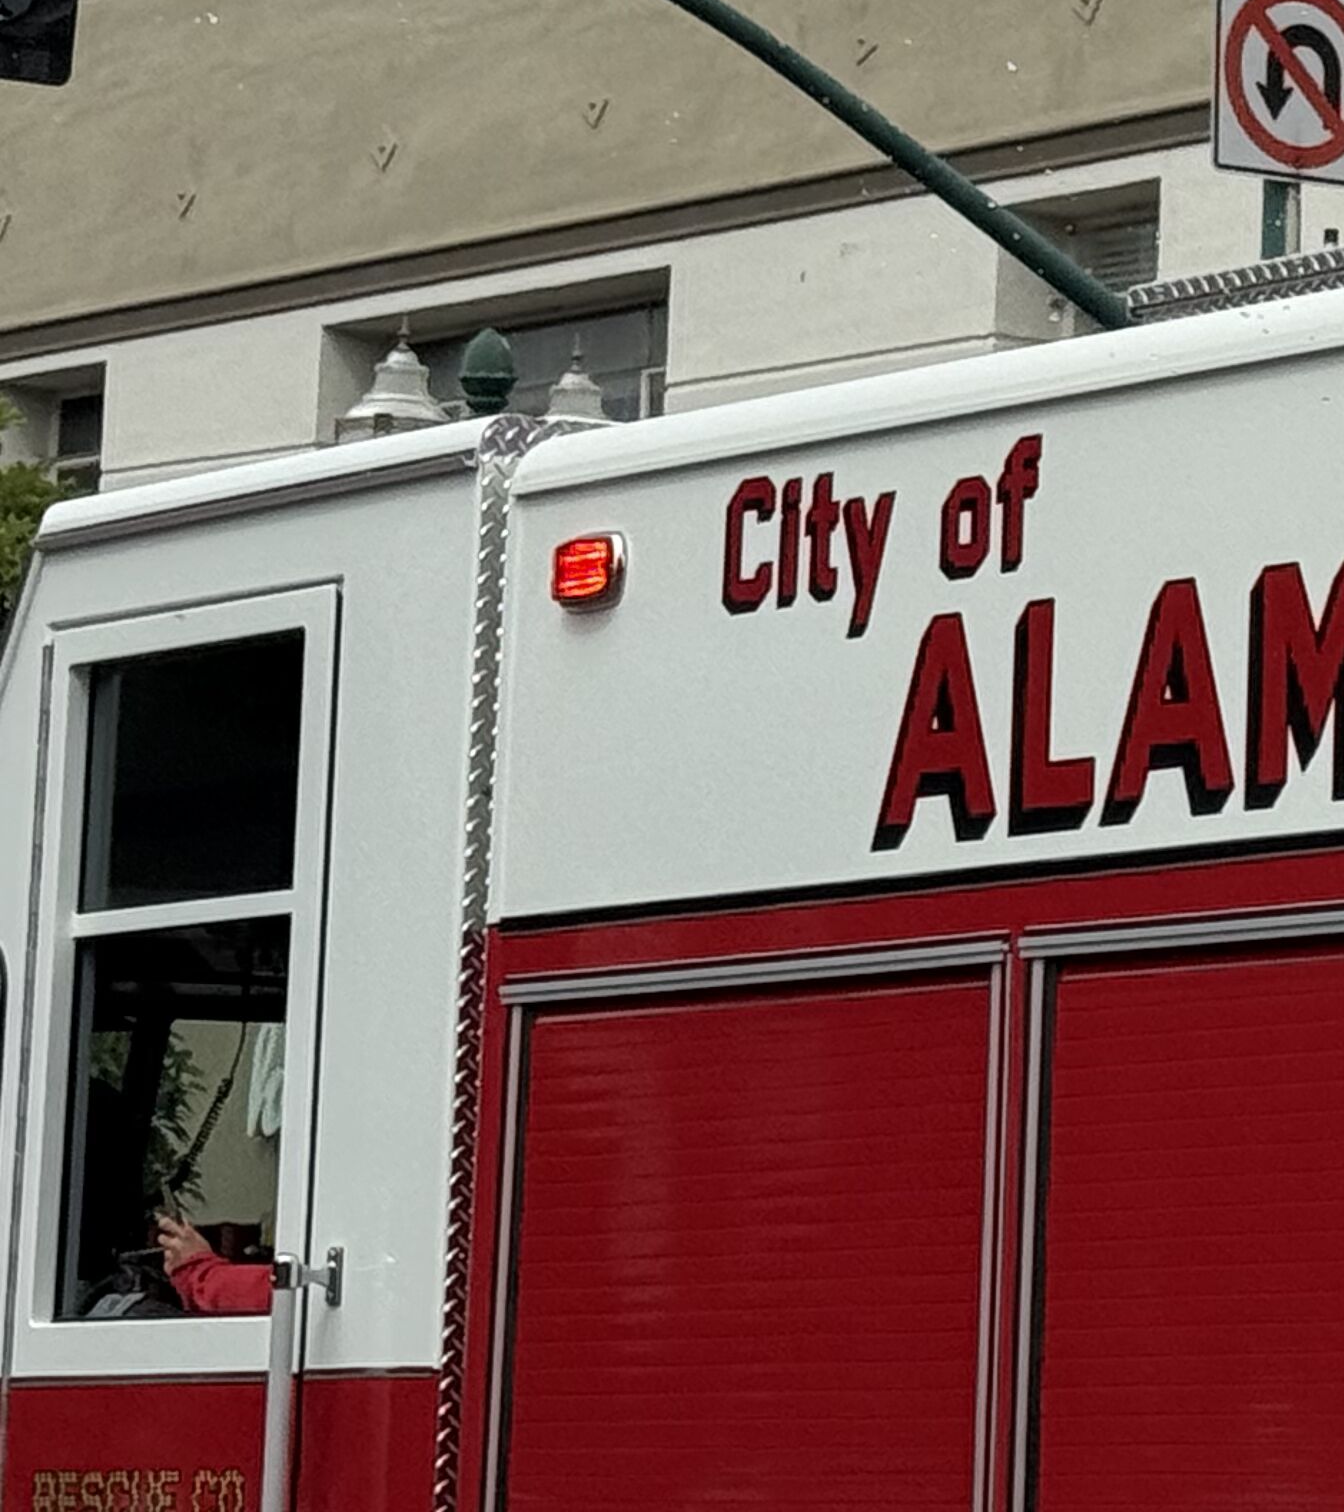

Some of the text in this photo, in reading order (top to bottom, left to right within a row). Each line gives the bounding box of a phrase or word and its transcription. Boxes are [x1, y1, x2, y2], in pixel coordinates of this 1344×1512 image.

[721, 433, 1043, 638] City of
[32, 1469, 181, 1512] RESCUE
